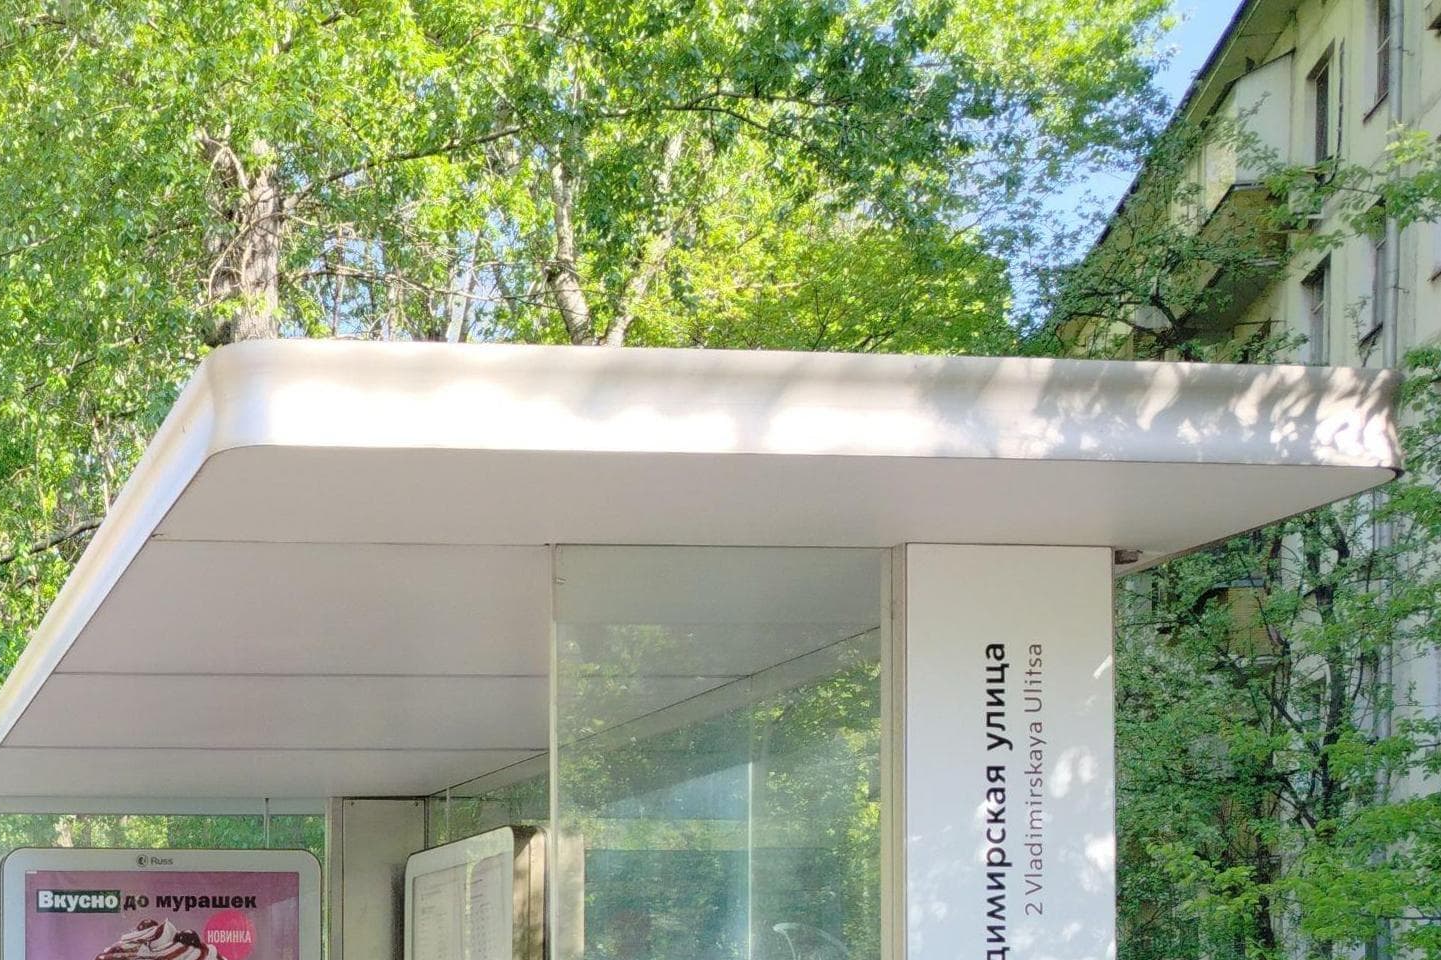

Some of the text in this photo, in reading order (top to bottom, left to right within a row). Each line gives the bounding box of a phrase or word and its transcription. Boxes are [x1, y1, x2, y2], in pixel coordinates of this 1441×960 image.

[985, 642, 1013, 752] улица
[1024, 642, 1048, 916] 2 Vladimirskaya Ulitsa
[150, 856, 173, 865] Russ
[38, 890, 257, 912] Вкусно до мурашек
[207, 930, 252, 944] НОВИНКА
